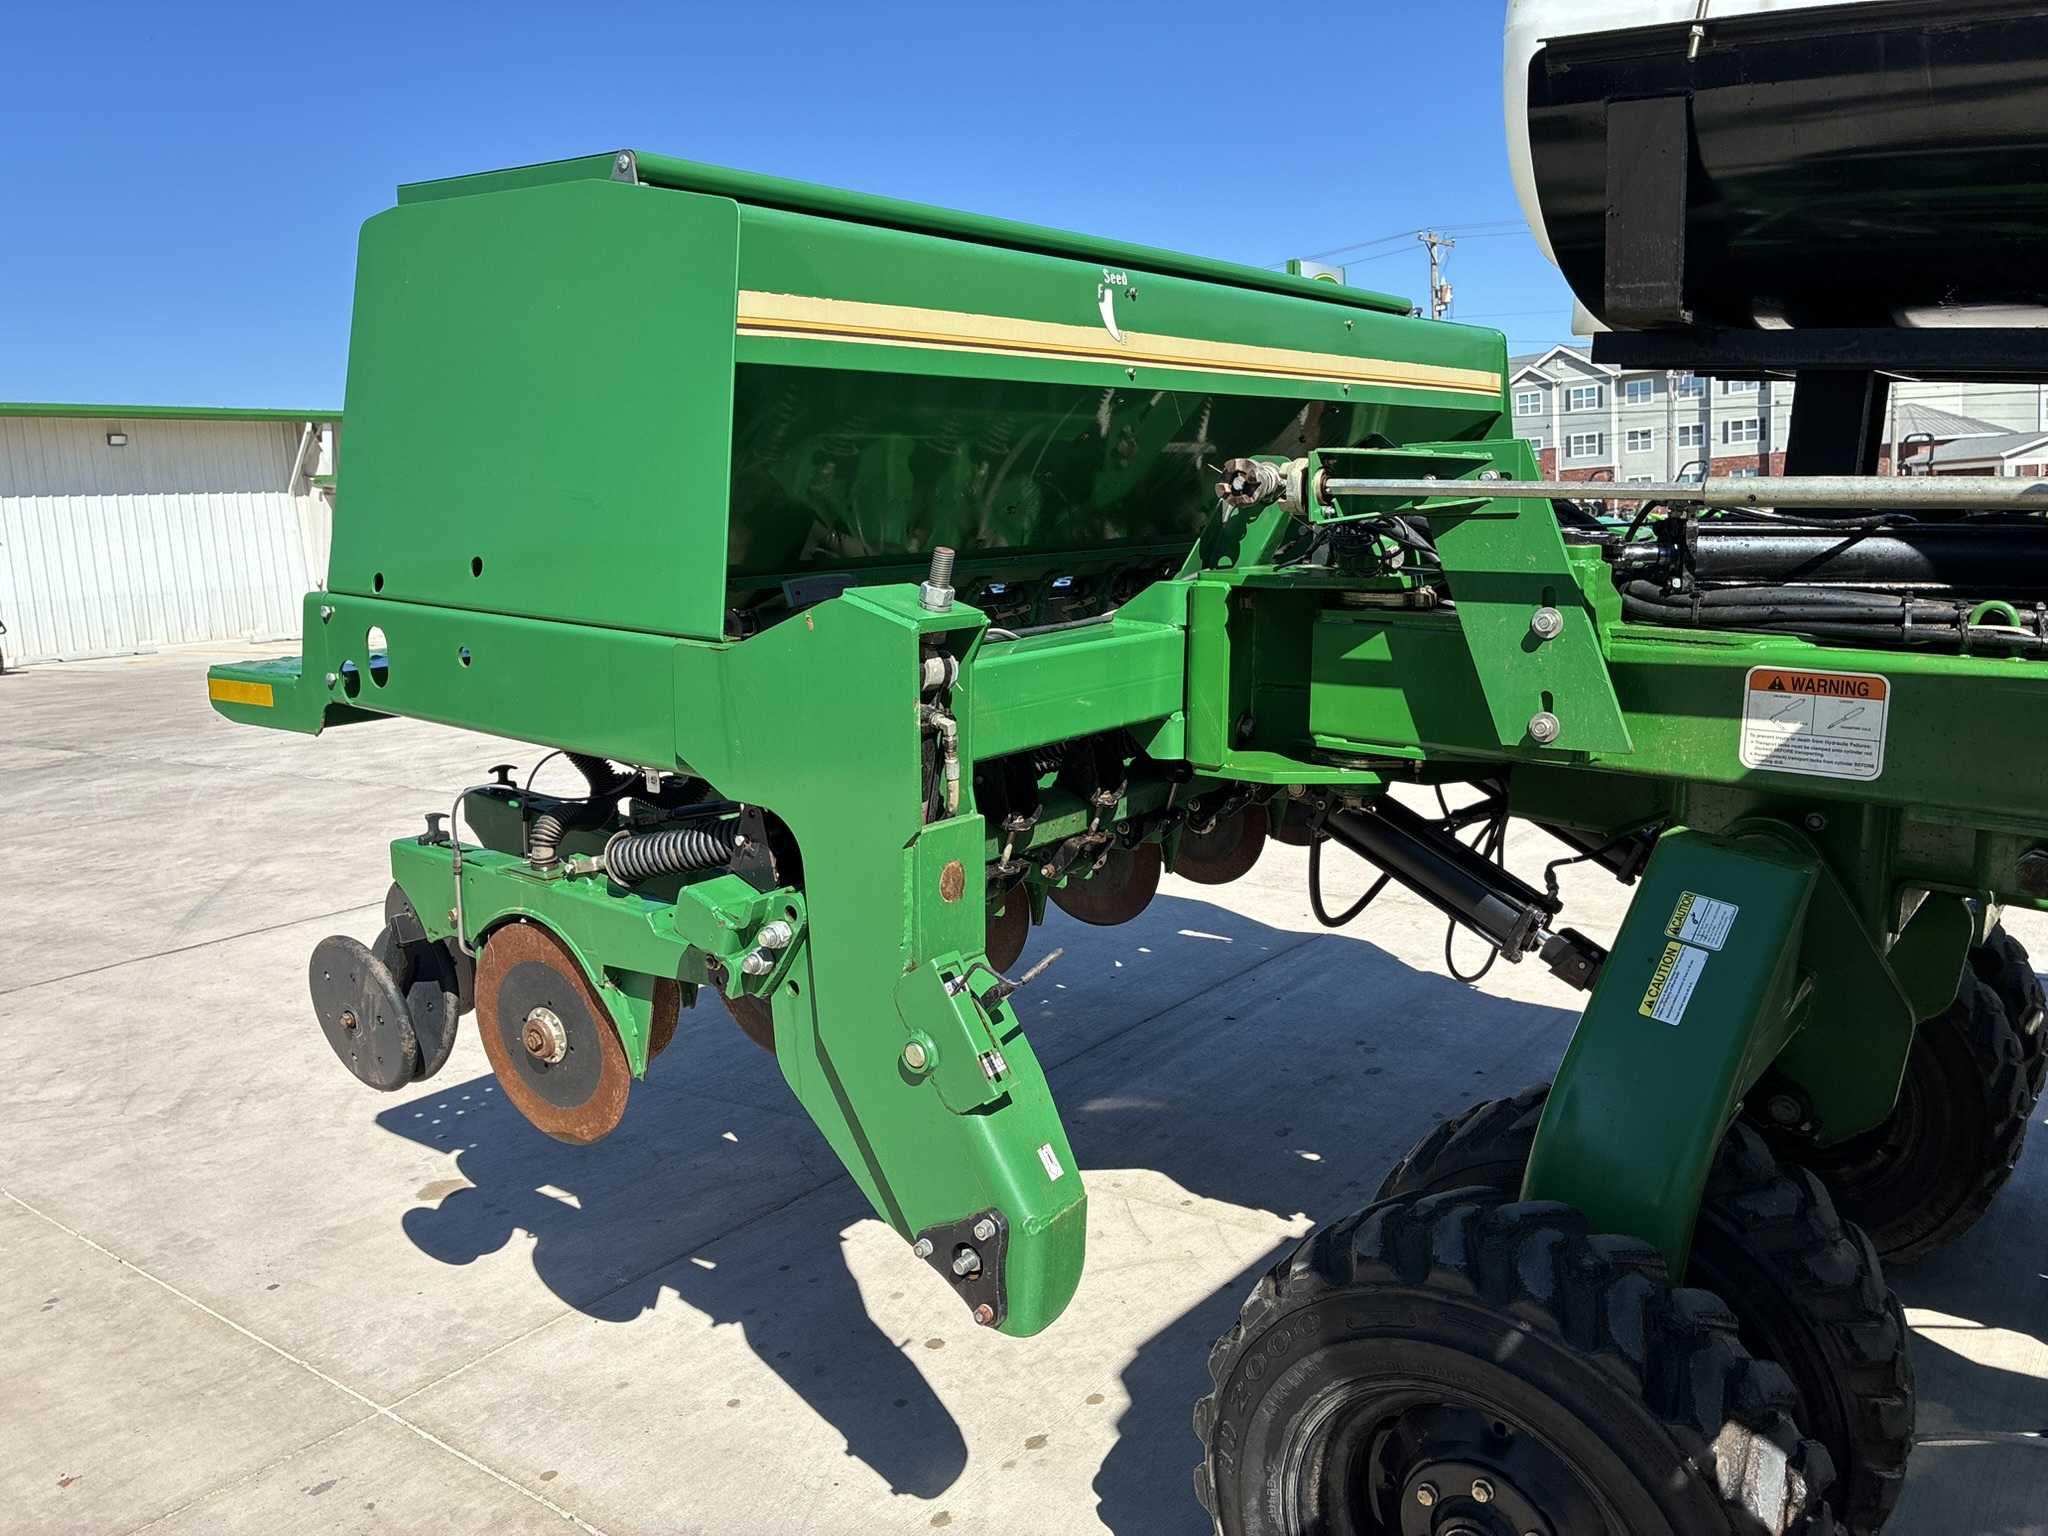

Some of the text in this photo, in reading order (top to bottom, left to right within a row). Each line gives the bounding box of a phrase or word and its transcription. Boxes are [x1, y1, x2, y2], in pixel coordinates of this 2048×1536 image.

[1103, 268, 1127, 285] Seed
[1098, 284, 1103, 299] F
[1121, 331, 1128, 346] E
[1791, 677, 1869, 697] WARNING
[1671, 893, 1694, 928] CAUTION
[1648, 947, 1678, 998] CAUTION
[1230, 1312, 1322, 1414] 2000
